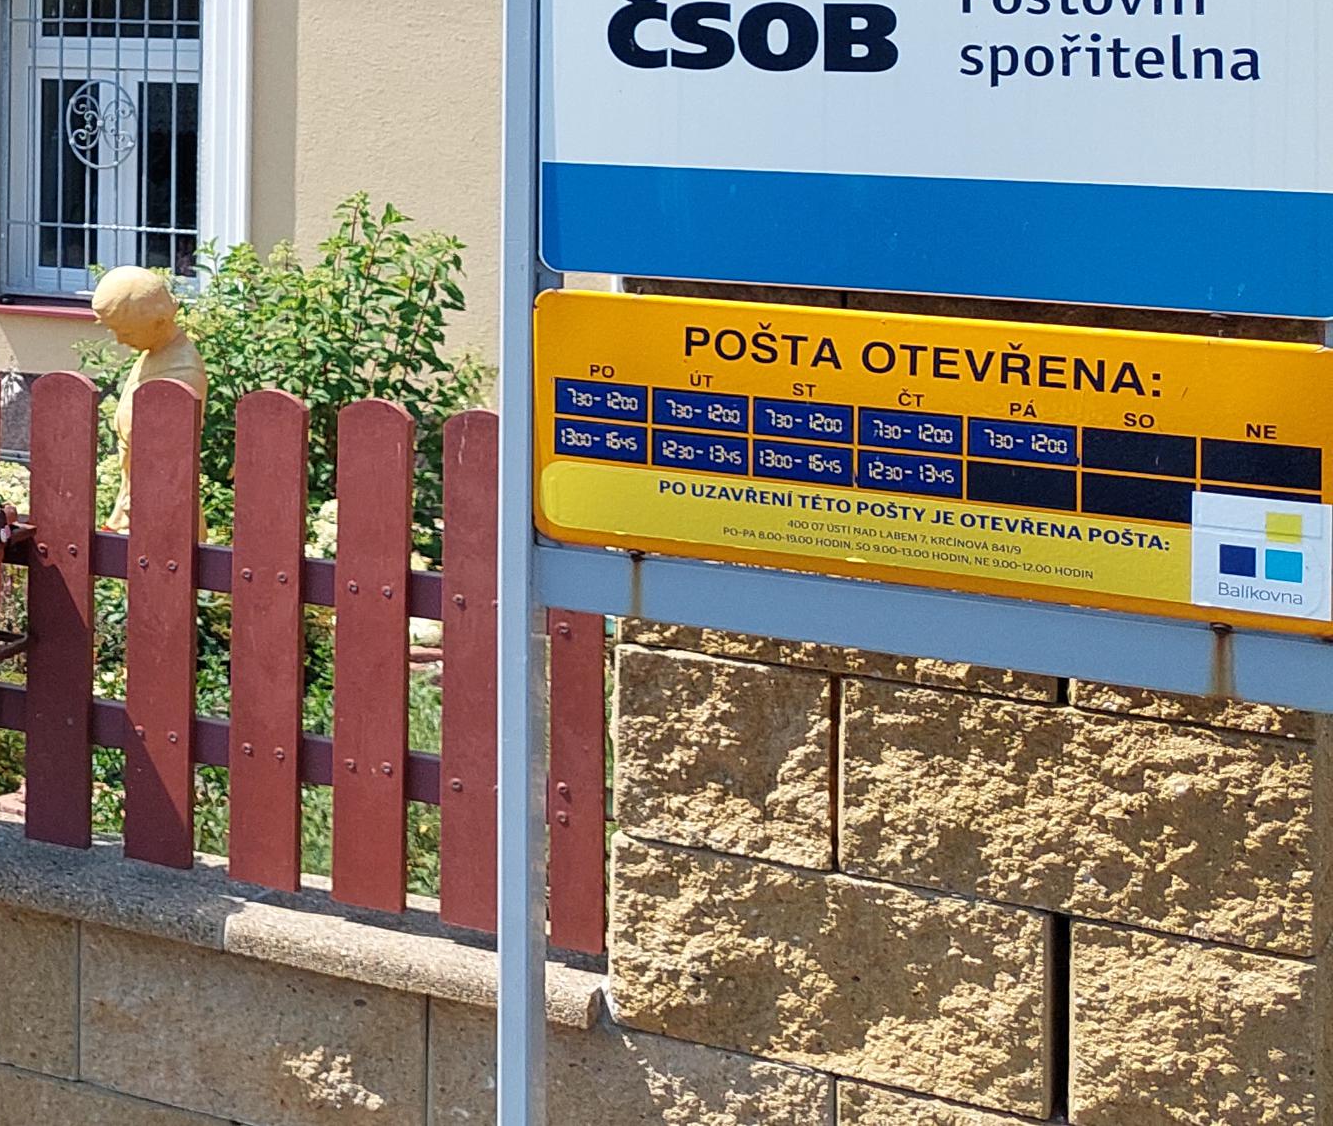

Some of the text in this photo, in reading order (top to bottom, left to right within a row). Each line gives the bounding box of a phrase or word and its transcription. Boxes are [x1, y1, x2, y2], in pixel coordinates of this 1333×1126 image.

[959, 32, 1261, 87] spořitelna
[684, 321, 1161, 398] POŠTA OTEVŘENA:
[589, 364, 1277, 440] PO ÚT ST ČT PÁ SO NE
[659, 479, 1171, 551] PO UZAVŘENÍ TÉTO POŠTY JE OTEVŘENA POŠTA:
[787, 519, 809, 529] 400
[811, 521, 825, 531] 07
[853, 527, 877, 538] NAD
[880, 530, 917, 543] LABEM
[991, 543, 1021, 555] 841/9
[758, 530, 813, 545] 8.00-19.00
[855, 541, 871, 551] SO
[872, 543, 930, 559] 9.00-13.00
[974, 556, 990, 567] NE
[992, 559, 1052, 574] 9.00-12.00
[1054, 566, 1094, 579] HODIN
[1217, 580, 1303, 605] Balíkovna
